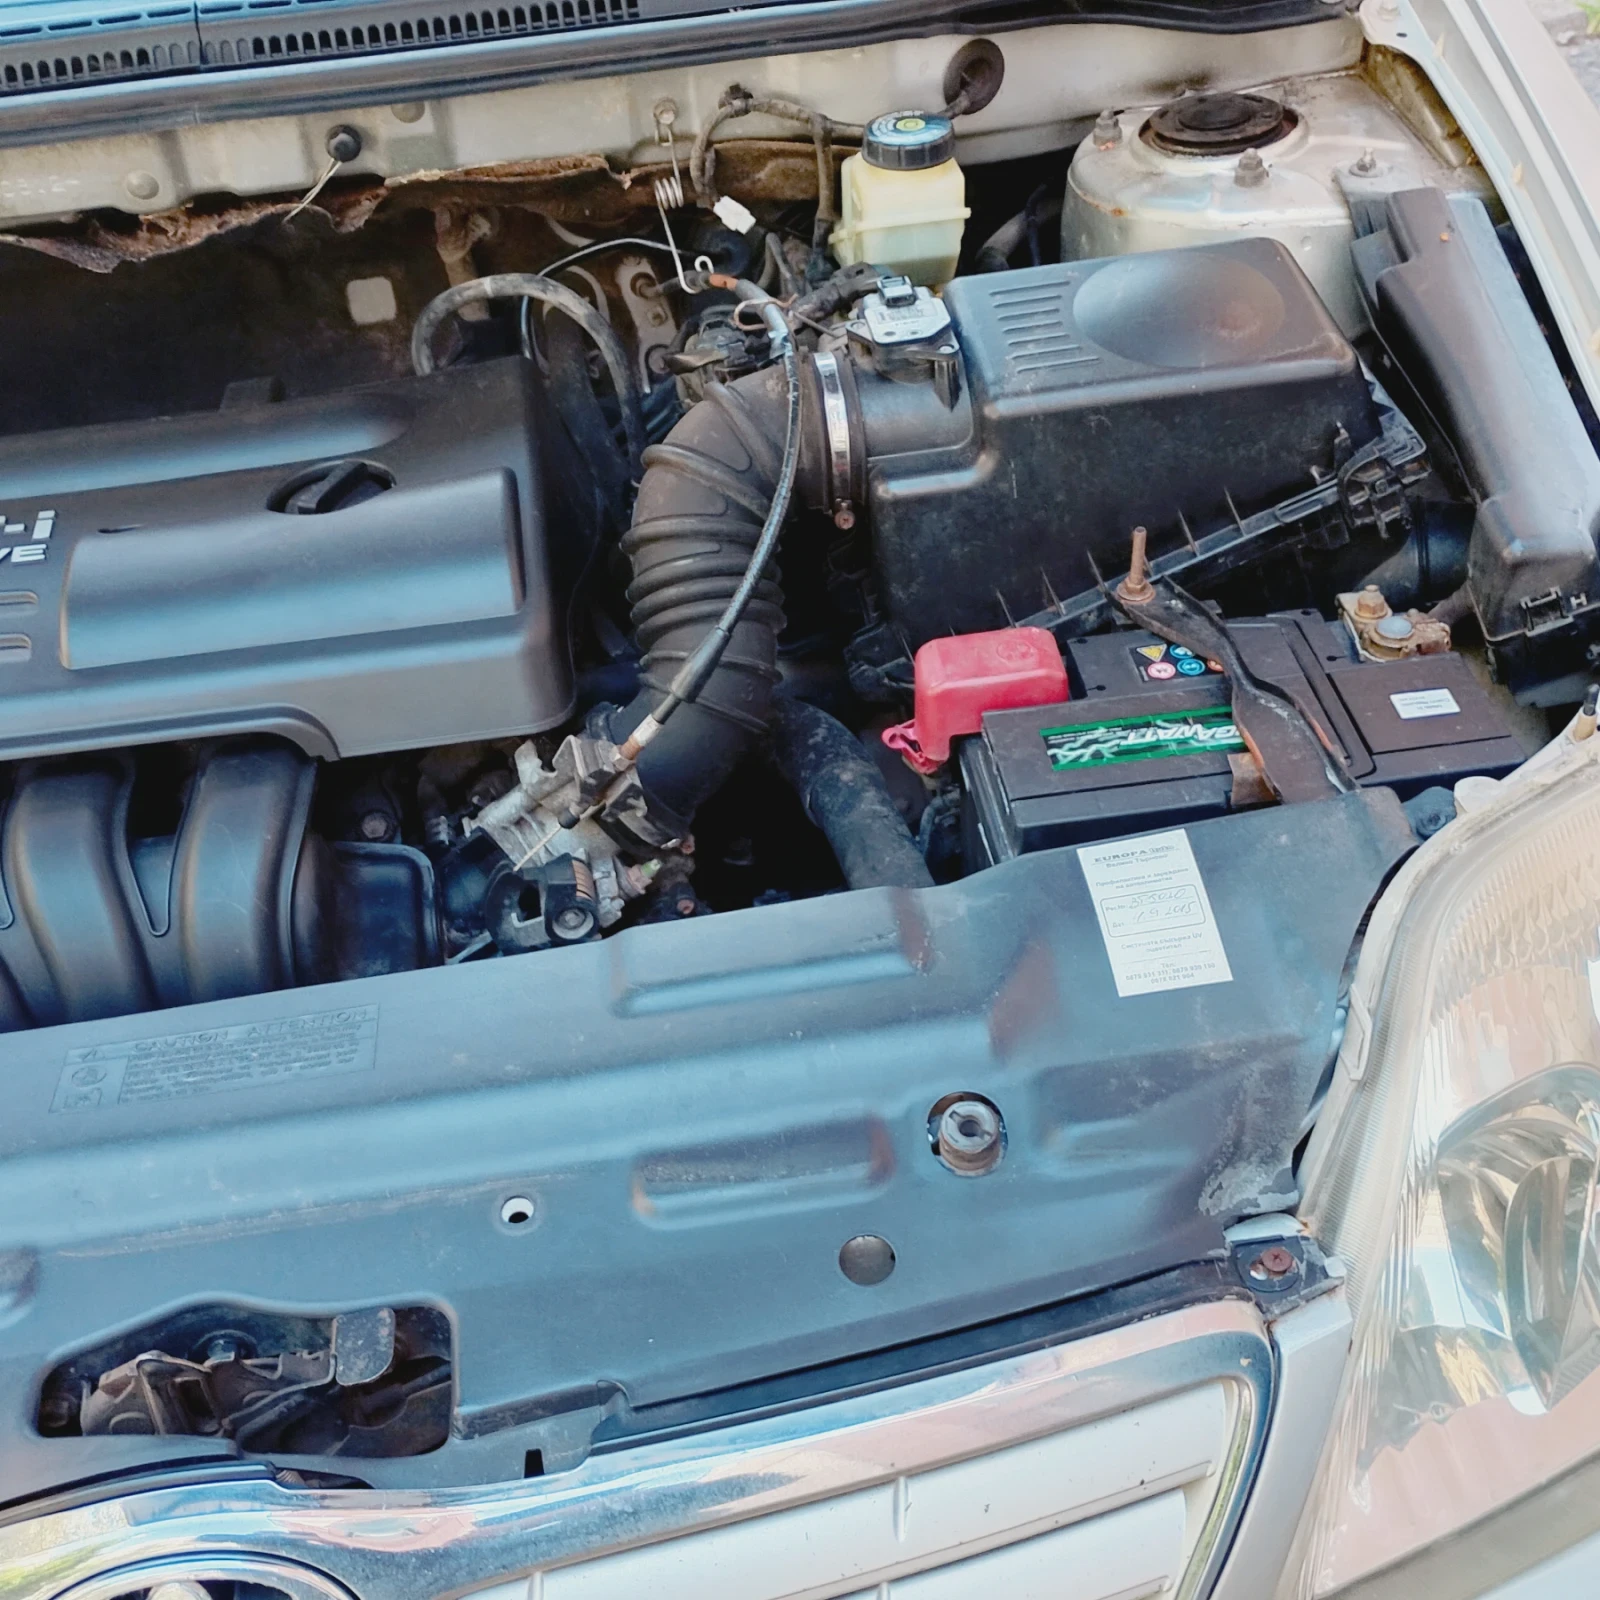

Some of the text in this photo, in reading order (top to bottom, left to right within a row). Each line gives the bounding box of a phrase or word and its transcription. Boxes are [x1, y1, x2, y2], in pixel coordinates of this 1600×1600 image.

[0, 510, 55, 540] -i
[1094, 849, 1147, 862] EUROPA
[135, 1009, 367, 1051] CAUTION ATTENTION
